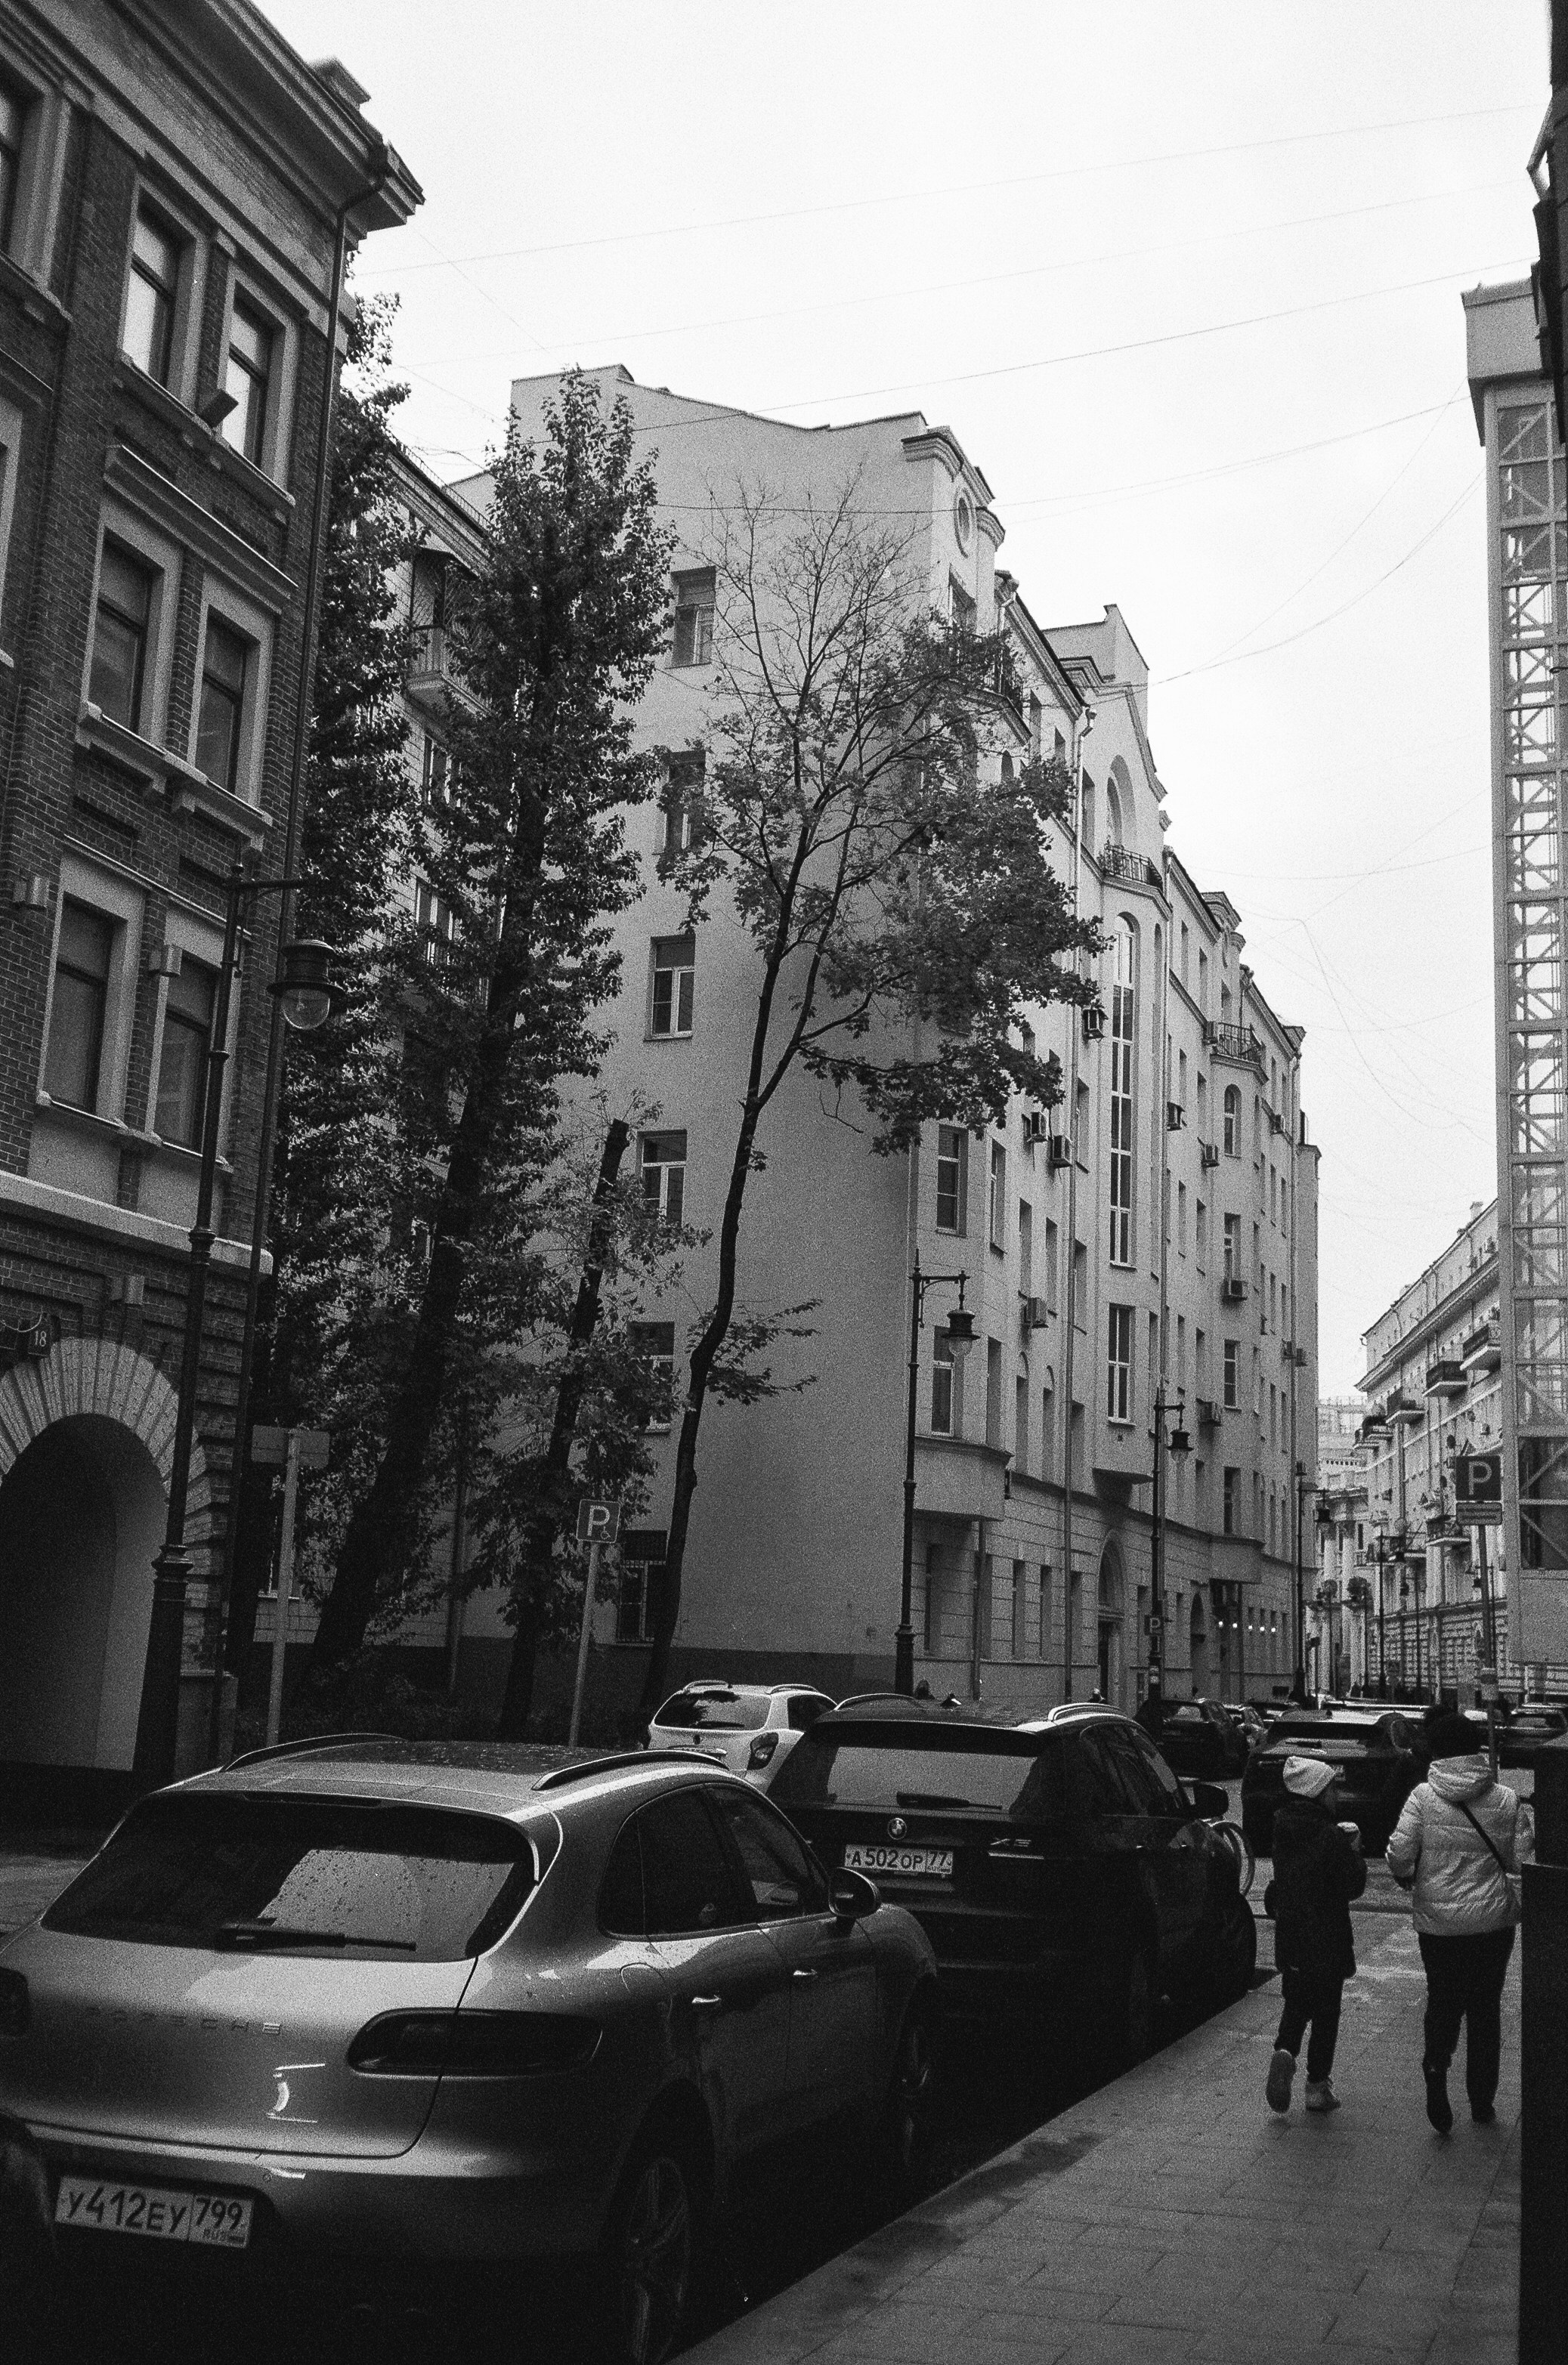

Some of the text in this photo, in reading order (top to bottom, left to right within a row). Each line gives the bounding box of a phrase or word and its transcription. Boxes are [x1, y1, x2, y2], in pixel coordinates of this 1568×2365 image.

[35, 1331, 47, 1347] 18
[1468, 1460, 1492, 1495] P
[587, 1505, 611, 1536] P
[1149, 1618, 1160, 1634] P
